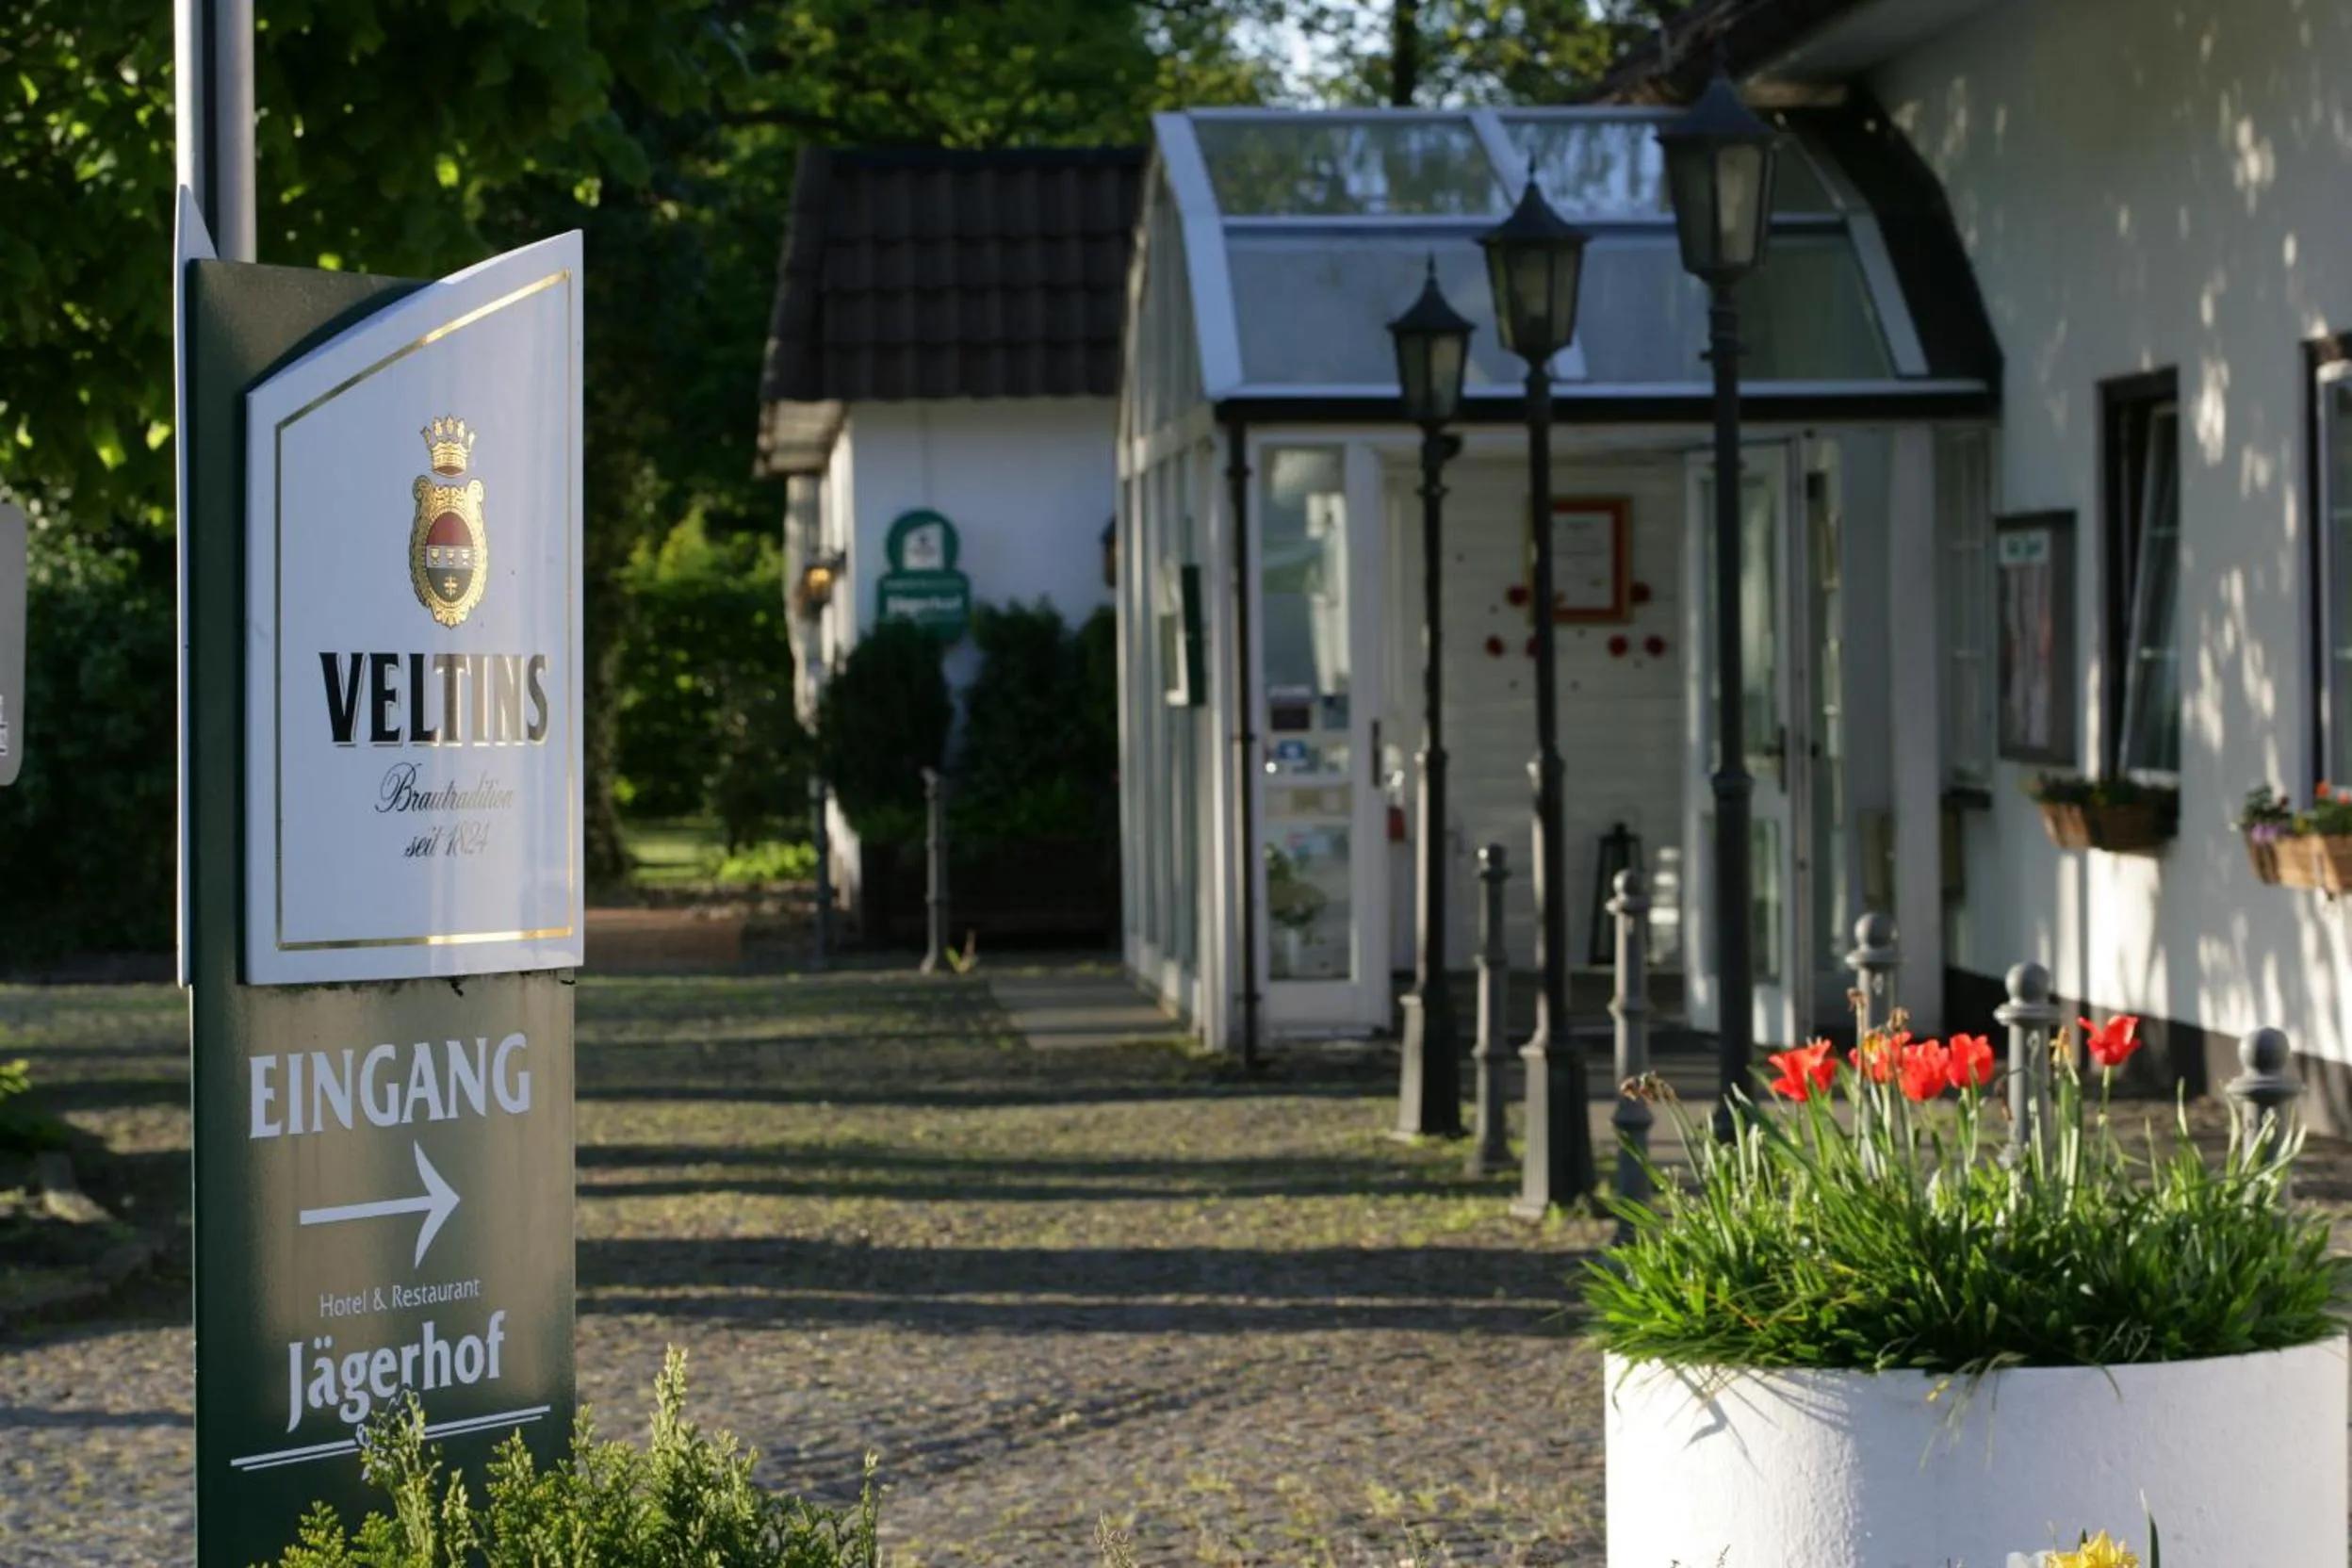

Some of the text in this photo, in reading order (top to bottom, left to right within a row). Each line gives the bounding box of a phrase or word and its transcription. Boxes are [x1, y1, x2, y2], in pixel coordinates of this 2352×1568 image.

[318, 652, 549, 747] VELTINS
[374, 761, 514, 813] Brautradition
[404, 822, 492, 858] seit 1824
[249, 1033, 531, 1139] EINGANG
[320, 1279, 482, 1318] Hotel & Restaurant
[286, 1310, 507, 1433] Jägerhof
